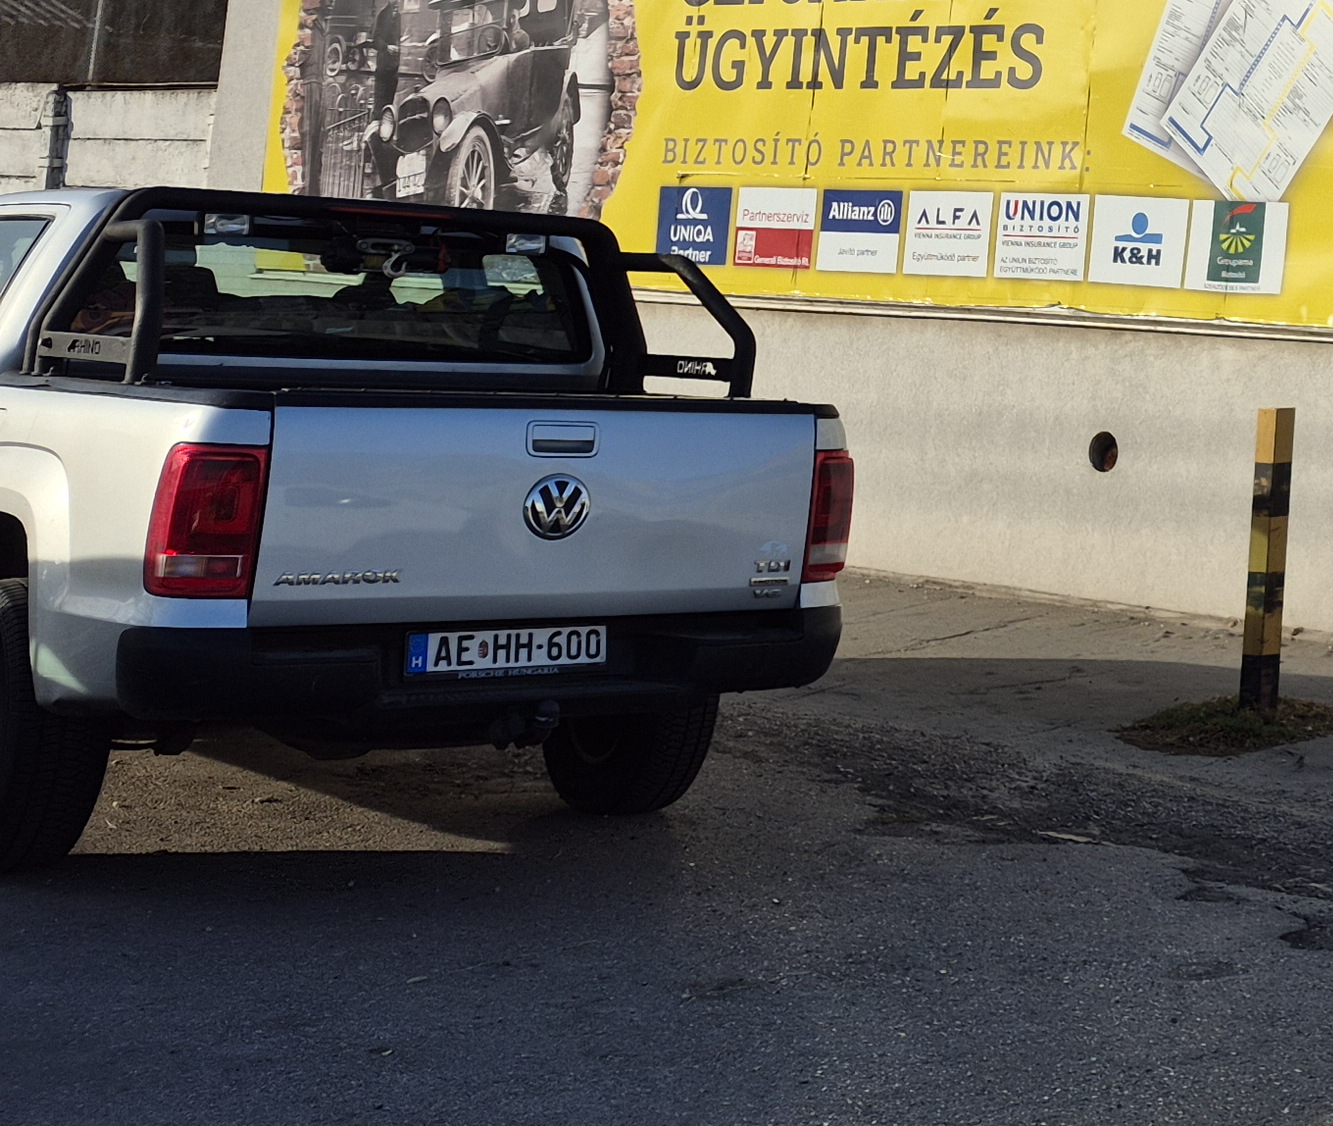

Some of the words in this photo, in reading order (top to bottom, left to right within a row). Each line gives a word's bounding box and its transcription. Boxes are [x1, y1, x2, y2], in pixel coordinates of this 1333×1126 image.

[673, 8, 1046, 91] ÜGYINTÉZÉS
[661, 132, 823, 166] BIZTOSÍTÓ
[837, 138, 1092, 172] PARTNEREINK:
[829, 202, 875, 220] Allianz
[917, 207, 981, 226] ALFA
[1005, 199, 1081, 222] UNION
[670, 225, 714, 242] UNIQA
[1002, 223, 1080, 234] BIZTOSÍTÓ
[1112, 245, 1162, 267] K&H
[754, 559, 791, 573] TDI
[273, 569, 401, 587] AMAROK
